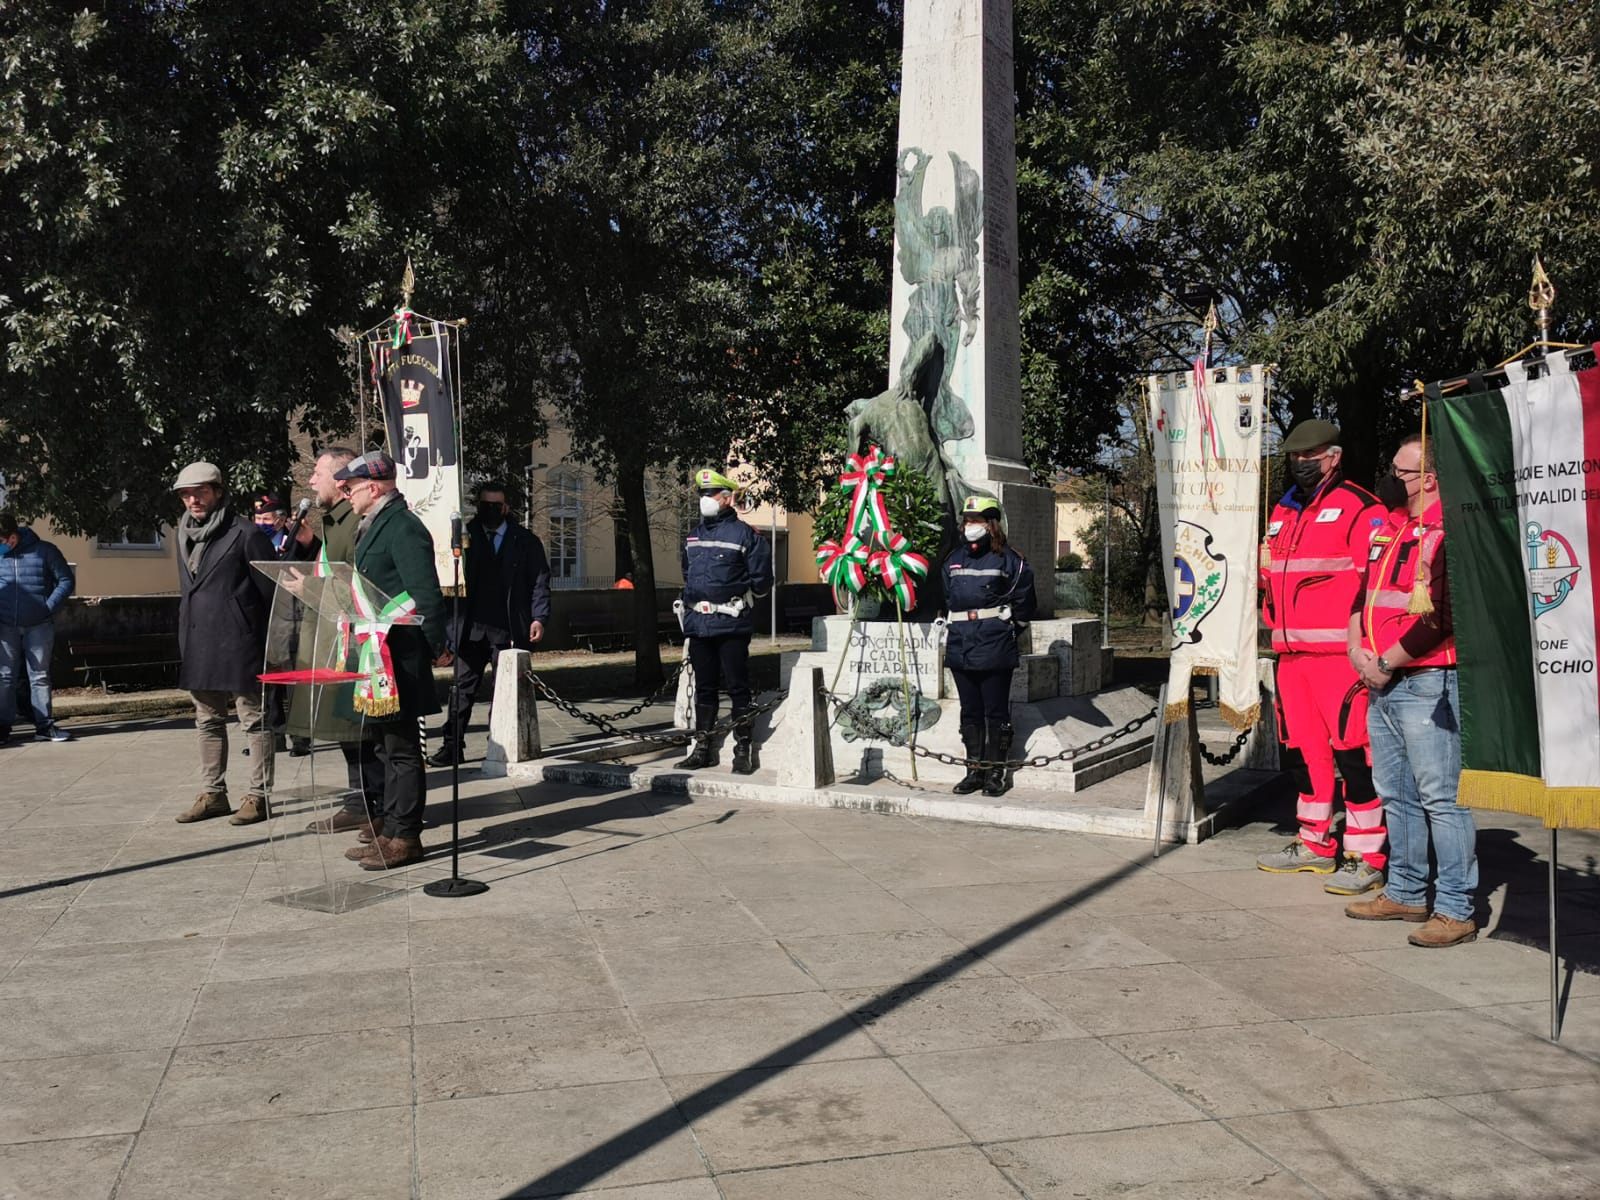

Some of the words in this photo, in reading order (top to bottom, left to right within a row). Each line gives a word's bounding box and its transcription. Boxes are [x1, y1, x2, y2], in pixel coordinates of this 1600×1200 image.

[886, 624, 895, 637] A
[869, 650, 919, 663] CADUTI
[1537, 659, 1594, 674] CCHIO
